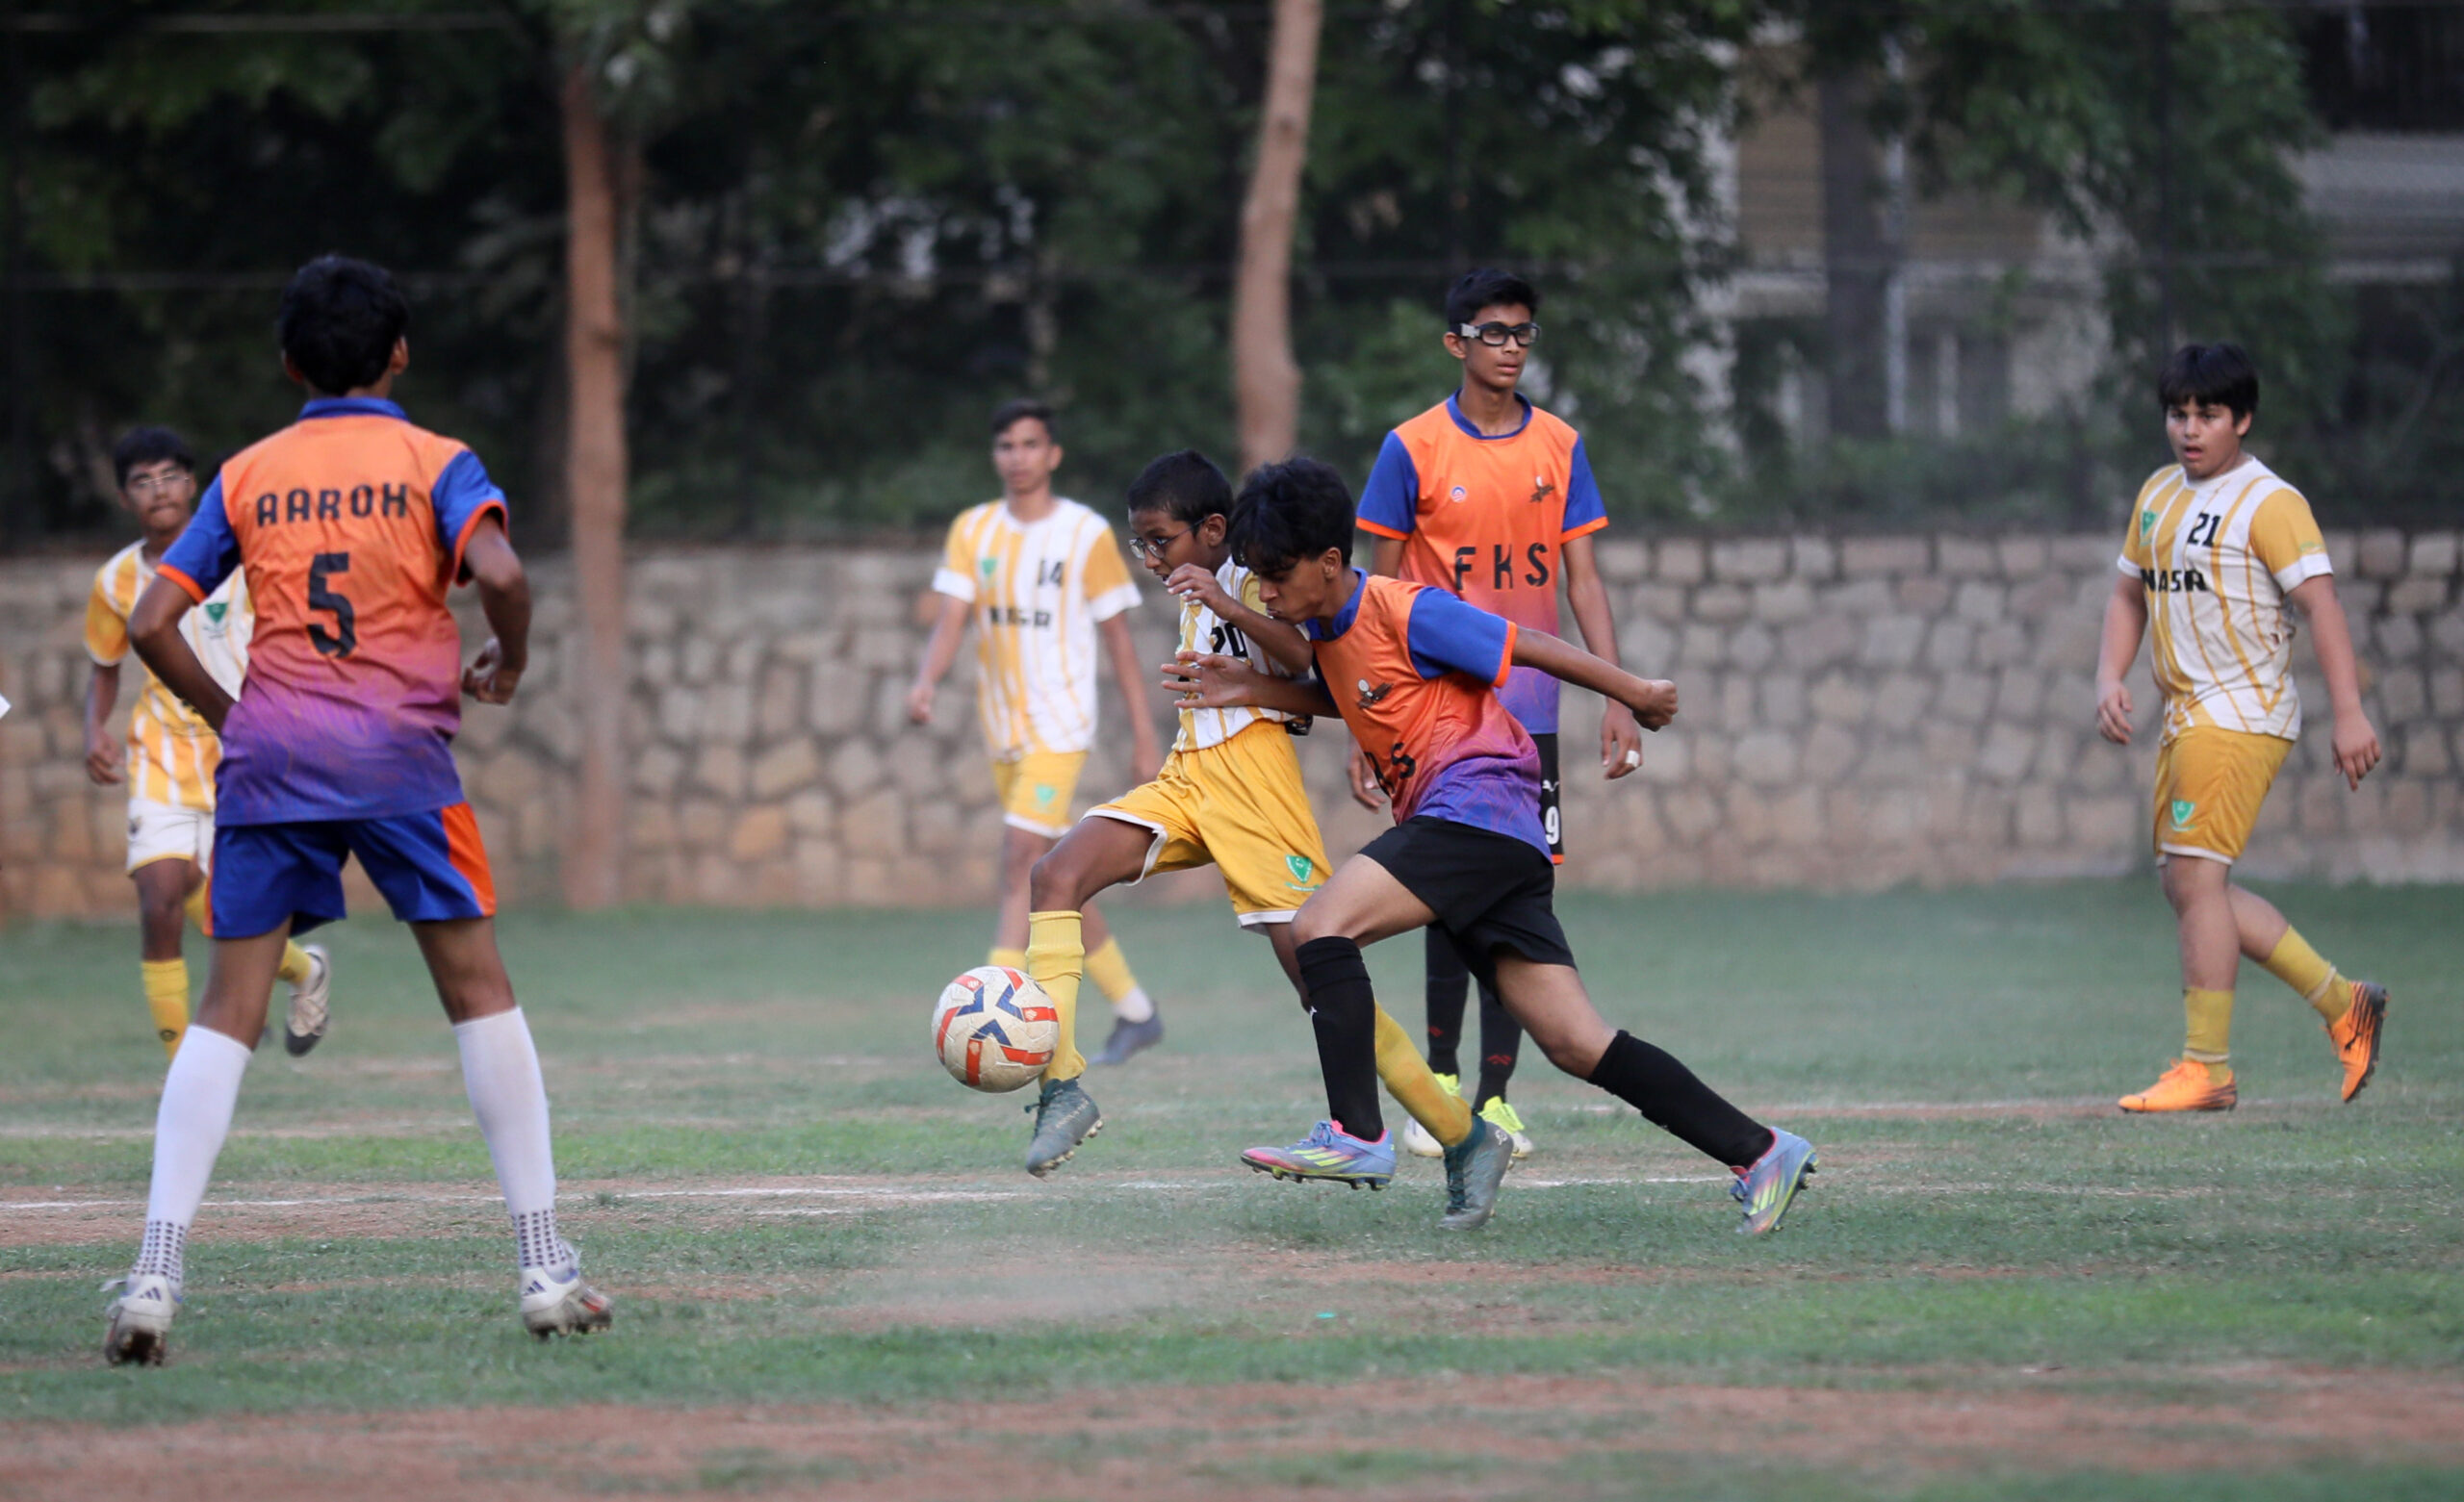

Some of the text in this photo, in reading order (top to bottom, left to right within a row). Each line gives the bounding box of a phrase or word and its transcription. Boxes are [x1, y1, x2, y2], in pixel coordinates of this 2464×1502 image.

[256, 483, 407, 527] AAROH
[2187, 512, 2221, 547] 21
[1038, 559, 1065, 588] 14
[2140, 568, 2208, 593] NASR
[305, 551, 357, 658] 5
[1545, 805, 1560, 845] 9
